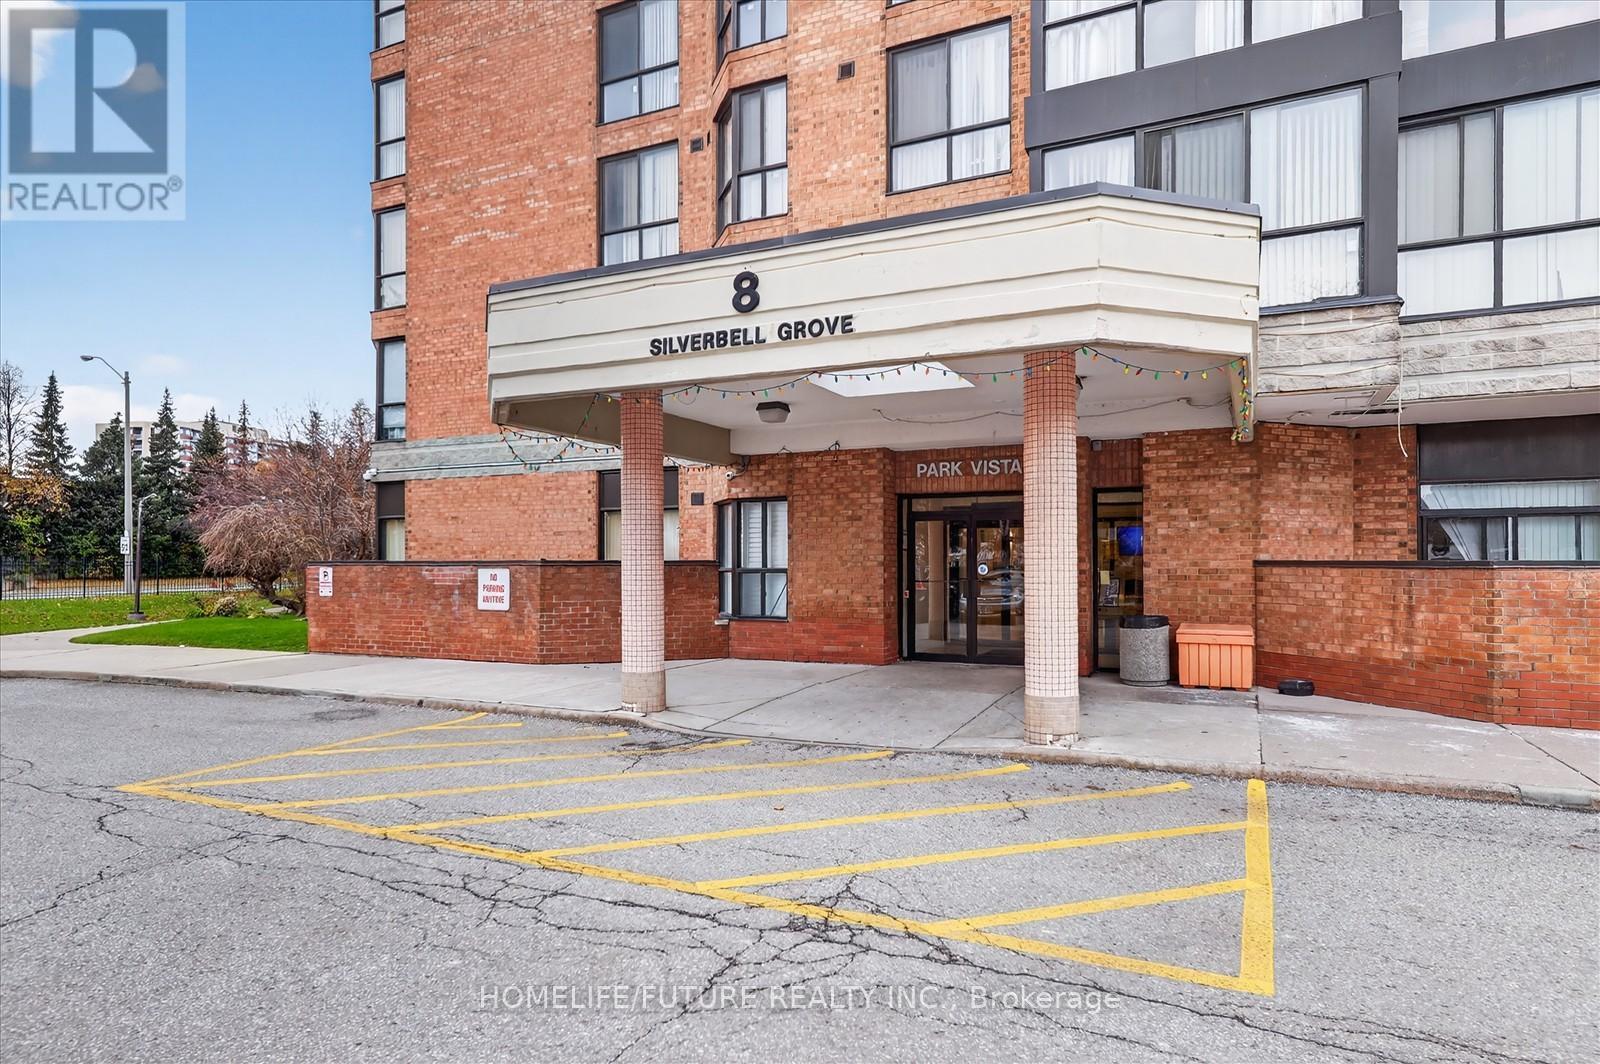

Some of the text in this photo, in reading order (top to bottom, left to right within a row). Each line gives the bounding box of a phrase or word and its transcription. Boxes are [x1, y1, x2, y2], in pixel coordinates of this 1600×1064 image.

[732, 271, 760, 313] 8
[650, 314, 854, 356] SILVERBELL GROVE
[916, 459, 1023, 478] PARK VISTA
